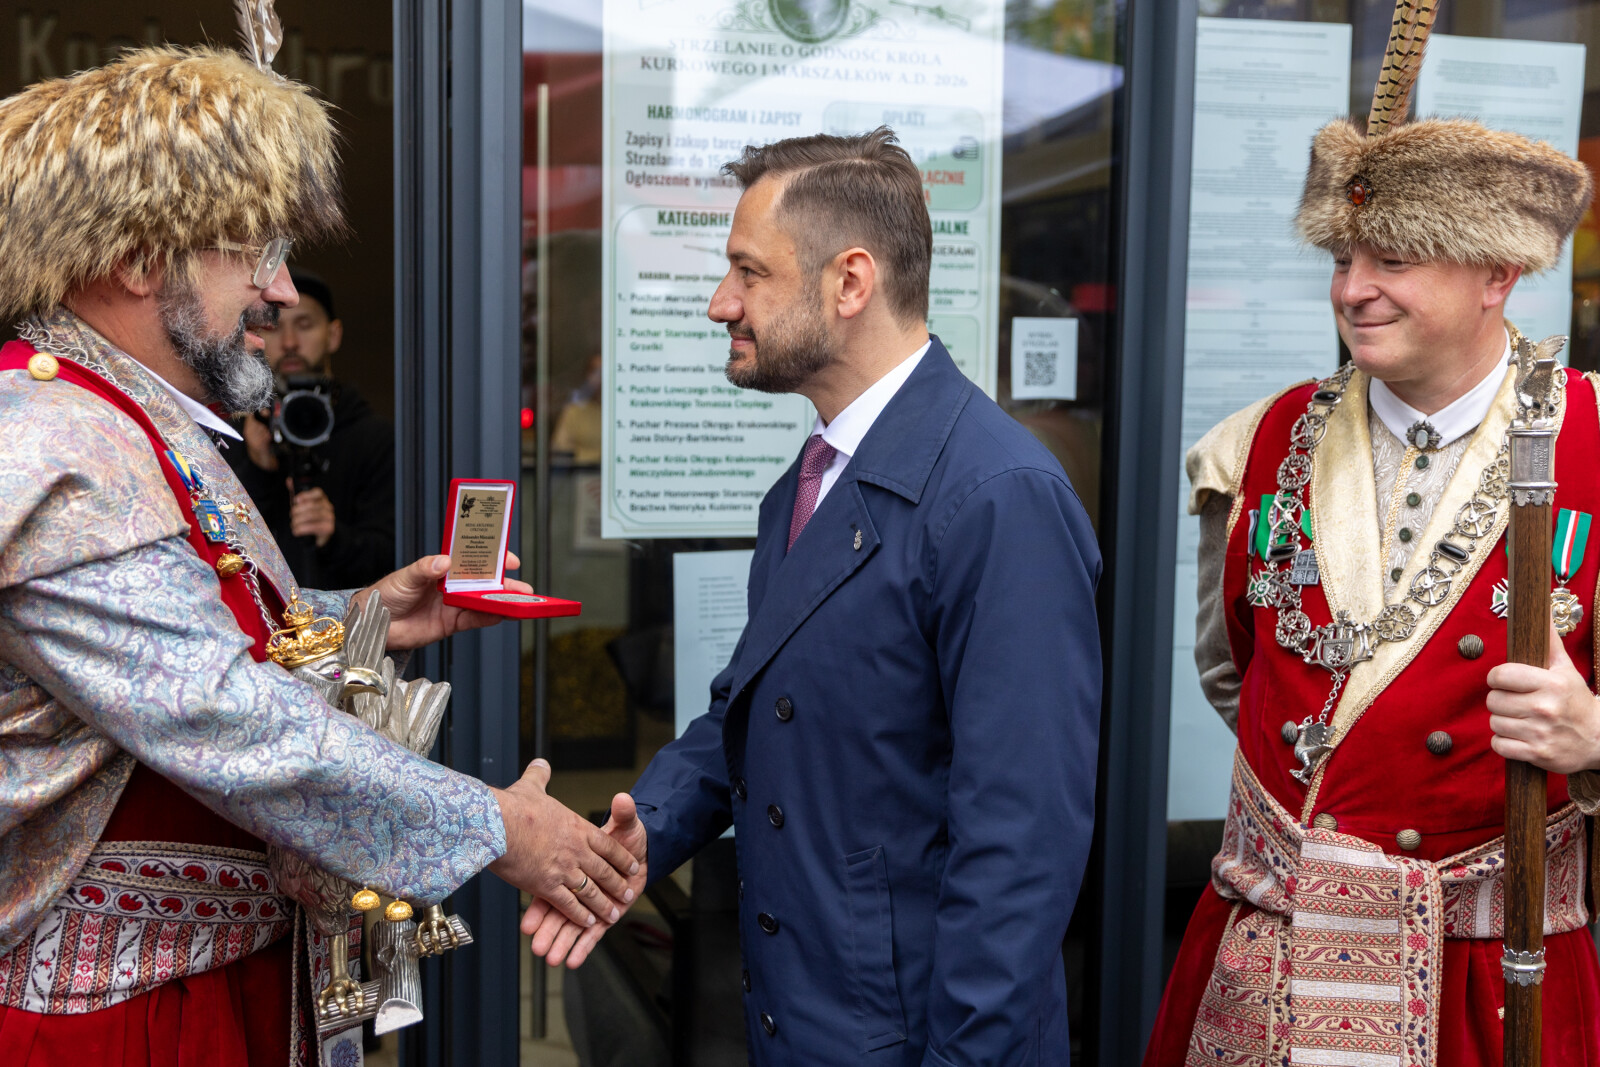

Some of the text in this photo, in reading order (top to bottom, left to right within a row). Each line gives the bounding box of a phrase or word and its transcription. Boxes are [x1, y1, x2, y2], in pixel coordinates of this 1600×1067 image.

[669, 39, 942, 67] STRZELANIE O GODNOŚĆ KRÓLA
[640, 56, 757, 76] KURKOWEGO
[761, 62, 767, 77] I
[771, 62, 892, 83] MARSZAŁKÓW
[934, 73, 969, 88] 2026
[647, 104, 747, 123] HARMONOGRAM
[759, 110, 803, 126] ZAPISY
[625, 130, 663, 148] Zapisy
[666, 132, 671, 147] i
[674, 135, 710, 150] zakup
[625, 151, 685, 168] Strzelanie
[689, 155, 703, 167] do
[625, 170, 740, 189] Ogłoszenie wynikó
[919, 170, 966, 188] ŁĄCZNIE
[657, 210, 731, 228] KATEGORIE
[933, 219, 970, 237] JALNE
[630, 328, 661, 338] Puchar
[664, 328, 708, 340] Starszego
[630, 363, 661, 373] Puchar
[630, 384, 662, 394] Puchar
[630, 399, 692, 410] Krakowskiego
[695, 399, 732, 409] Tomasza
[630, 419, 661, 429] Puchar
[664, 420, 700, 429] Prezesa
[702, 420, 734, 431] Okręgu
[737, 421, 798, 432] Krakowskiego
[630, 434, 652, 443] Jana
[630, 454, 661, 464] Puchar
[664, 455, 688, 463] Króla
[690, 455, 722, 465] Okręgu
[630, 489, 661, 499] Puchar
[663, 489, 720, 499] Honorowego
[630, 503, 667, 512] Bractwa
[669, 503, 706, 513] Henryka
